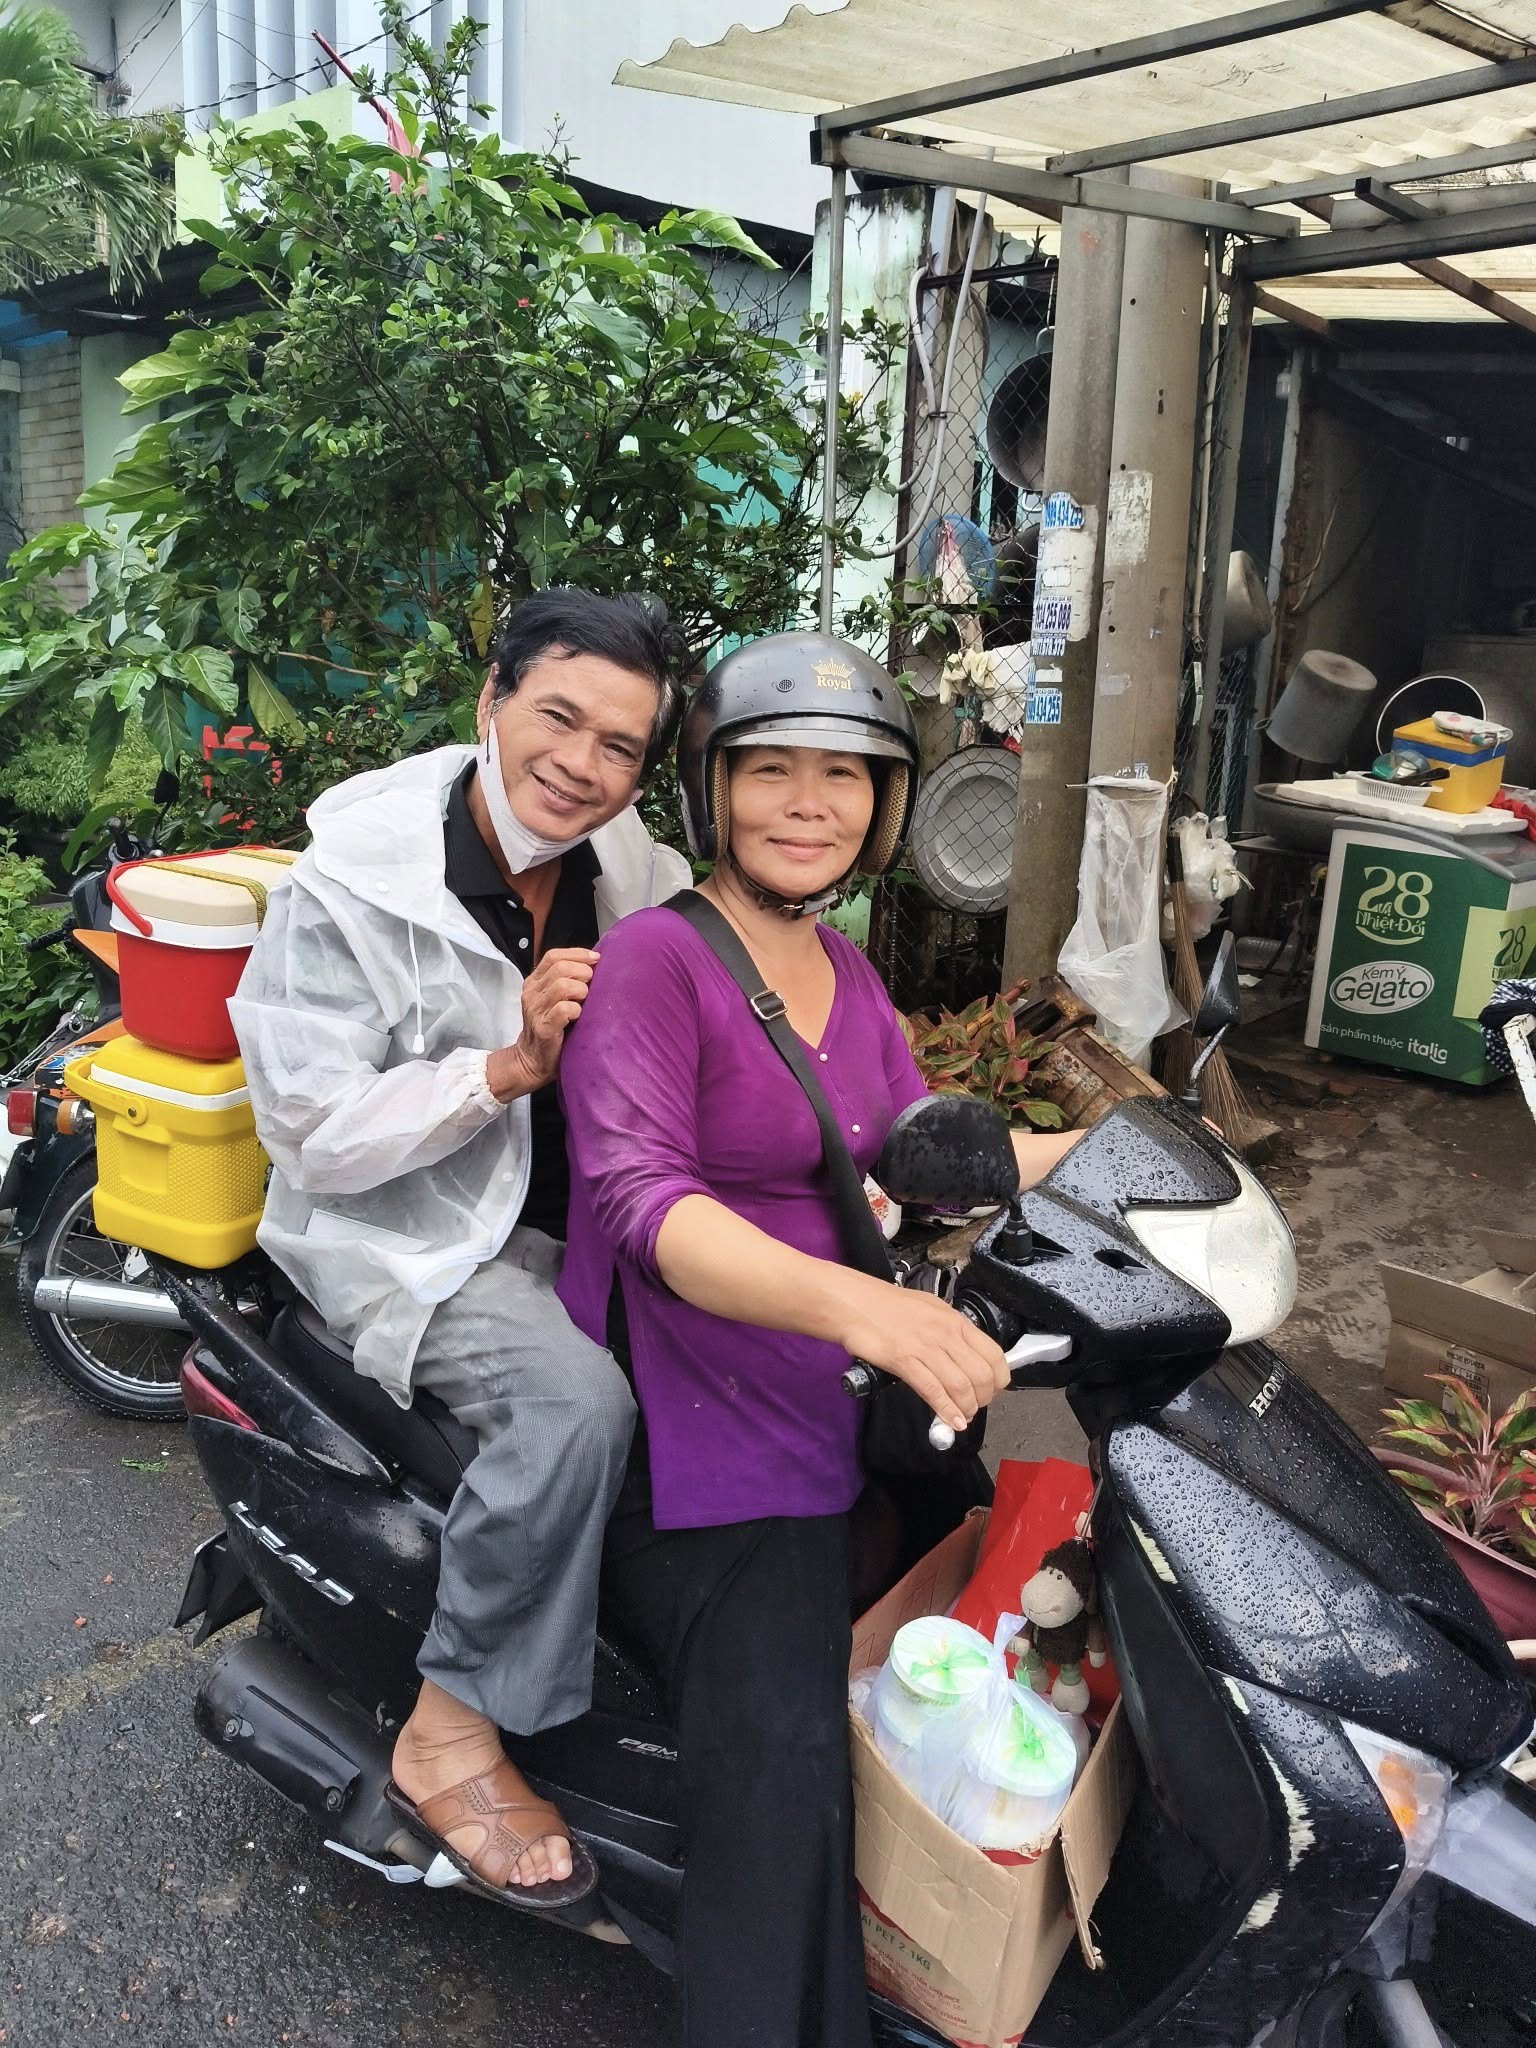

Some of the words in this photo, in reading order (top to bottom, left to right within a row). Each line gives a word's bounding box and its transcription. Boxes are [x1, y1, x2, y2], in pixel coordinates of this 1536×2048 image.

[816, 675, 852, 690] Royal
[1358, 866, 1433, 919] 28
[1494, 925, 1526, 967] 28
[1362, 966, 1394, 980] Kem
[1372, 1034, 1404, 1049] thuộc
[228, 1500, 354, 1606] LEAD
[875, 1924, 895, 1945] PET
